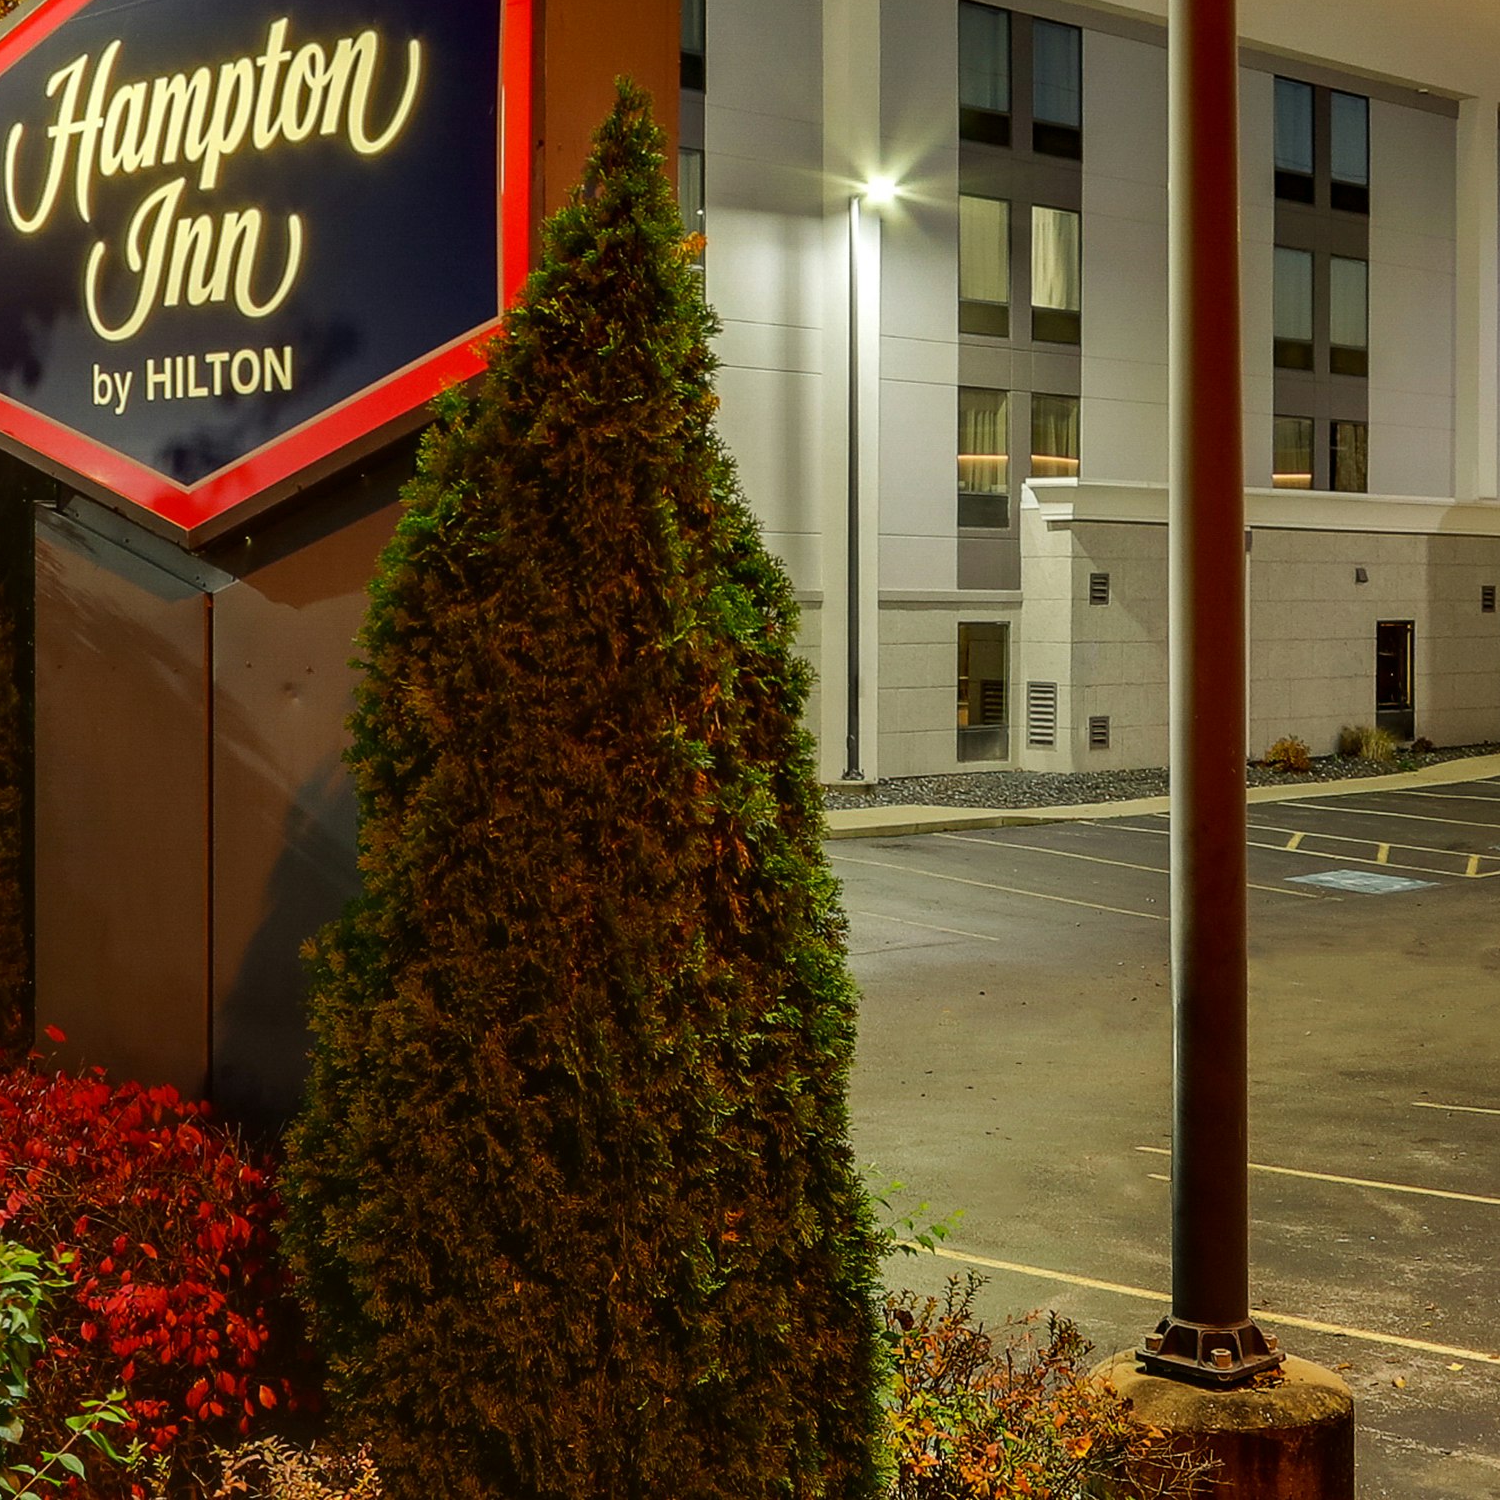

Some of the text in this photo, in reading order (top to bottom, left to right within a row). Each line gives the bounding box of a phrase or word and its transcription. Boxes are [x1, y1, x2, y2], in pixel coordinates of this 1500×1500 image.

[4, 16, 421, 234] Hampton
[84, 177, 303, 343] Inn
[92, 345, 293, 416] by HILTON
